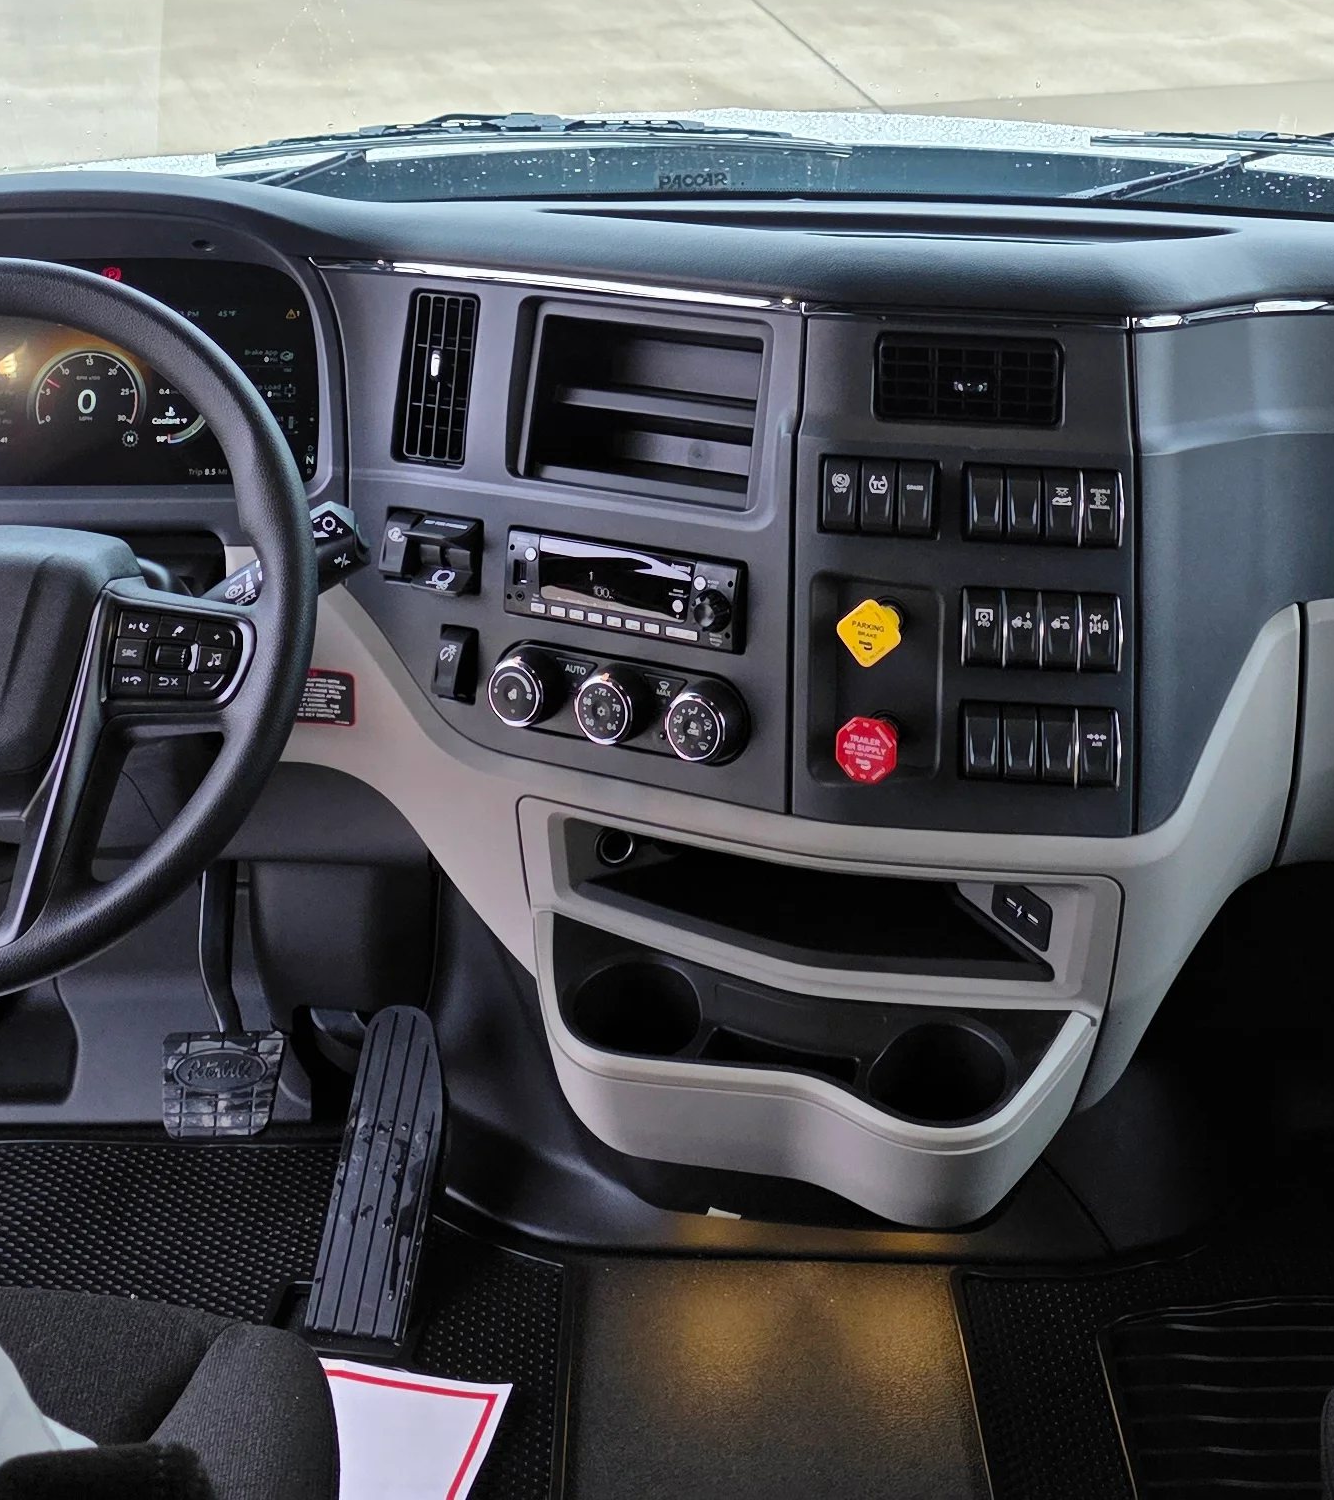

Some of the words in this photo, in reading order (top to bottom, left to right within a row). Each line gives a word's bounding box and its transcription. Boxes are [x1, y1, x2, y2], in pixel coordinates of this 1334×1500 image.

[658, 171, 729, 191] PACCAR
[77, 389, 97, 414] 0
[305, 455, 315, 465] N
[188, 468, 204, 477] Trip
[204, 468, 216, 476] 8.5
[872, 480, 885, 490] TC
[851, 620, 885, 633] PARKING
[857, 630, 877, 640] BRAKE
[121, 648, 138, 657] SRC
[564, 664, 587, 676] AUTO
[597, 687, 607, 697] 72
[656, 687, 672, 698] MAX
[849, 734, 881, 747] TRAILER
[842, 741, 856, 751] AIR
[857, 743, 887, 756] SUPPLY
[186, 1060, 252, 1081] Peterbilt
